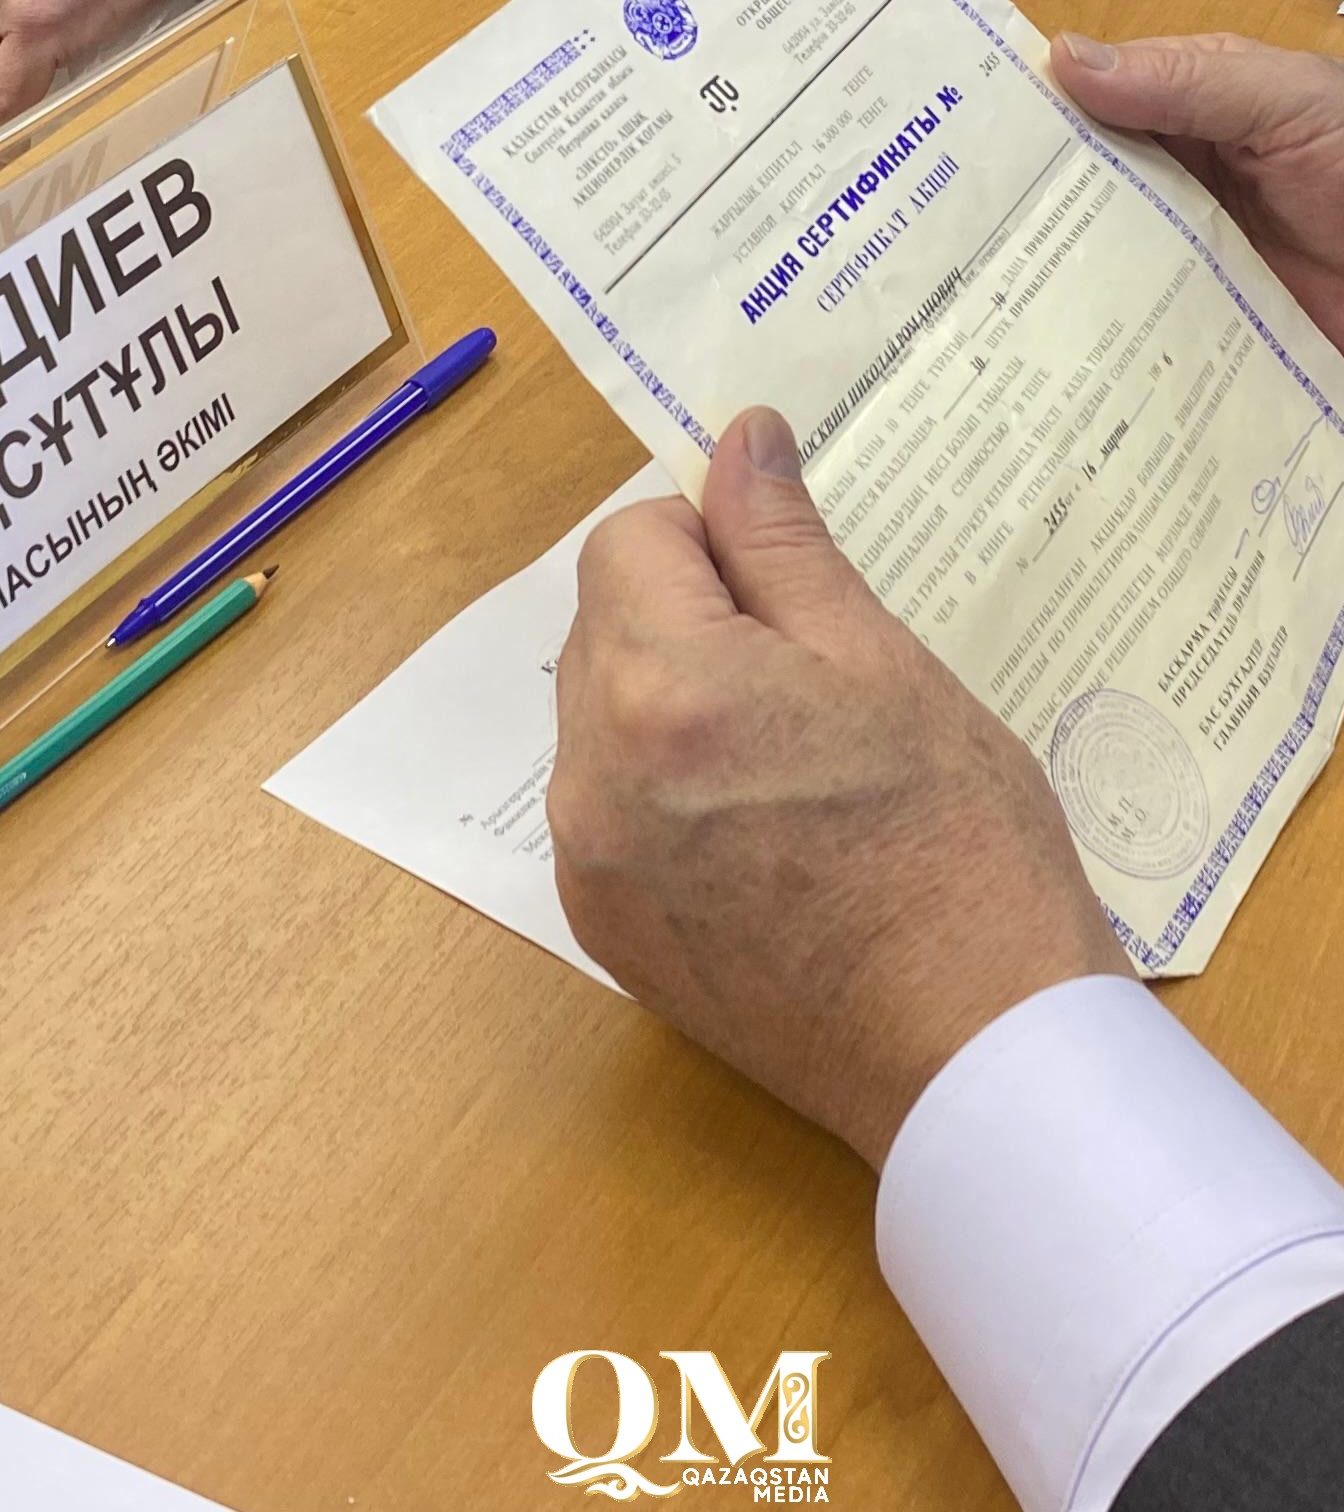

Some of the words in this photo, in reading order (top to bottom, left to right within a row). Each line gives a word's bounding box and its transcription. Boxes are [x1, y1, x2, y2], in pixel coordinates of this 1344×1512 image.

[559, 45, 627, 107] РЕСПУБЛИКАСЫ
[756, 140, 803, 189] КАПИТАЛ
[779, 163, 826, 214] КАПИТАЛ
[741, 252, 804, 324] АКЦИЯ
[798, 106, 940, 257] СЕРТИФИКАТЫ
[817, 209, 908, 312] СЕРТИФИКАТ
[910, 153, 959, 213] АКЦИЙ
[1001, 256, 1028, 288] ДАНА
[834, 488, 880, 546] ВЛЯЕТСЯ
[874, 416, 937, 493] ВЛАДЕЛЬЦЕМ
[984, 317, 1014, 349] ШТУК
[1009, 211, 1095, 318] ПРИВИЛЕГИРОВАННЫХ
[848, 339, 900, 408] НИКОЛАЙ
[896, 267, 963, 349] РОМАНОВИЧ
[156, 393, 237, 477] ӘКІМІ
[945, 414, 981, 458] БОЛЫП
[951, 422, 1009, 497] СТОИМОСТЬЮ
[1100, 419, 1129, 461] марта
[917, 545, 959, 600] ТУРАЛЫ
[1061, 365, 1092, 402] ЖАЗБА
[933, 595, 959, 624] ЧЕМ
[964, 571, 976, 585] В
[978, 521, 1014, 566] КНИГЕ
[1017, 428, 1078, 510] РЕГИСТРАЦИИ
[1075, 382, 1112, 431] СДЕЛАНА
[1090, 488, 1136, 554] АКЦИЯЛАР
[1104, 596, 1161, 672] РЕШЕНИЕМ
[1172, 614, 1237, 707] ПРЕДСЕДАТЕЛЬ
[1232, 550, 1265, 614] ПРАВЛЕНИЯ
[1000, 652, 1049, 721] ВИДЕНДЫ
[1048, 630, 1065, 653] ПО
[1199, 707, 1221, 735] БАС
[1218, 639, 1263, 708] БУХГАЛТЕР
[1213, 684, 1260, 751] ГЛАВНЫЙ
[1257, 626, 1288, 687] БУХГАЛТЕР
[1024, 693, 1062, 746] НАЛЫС
